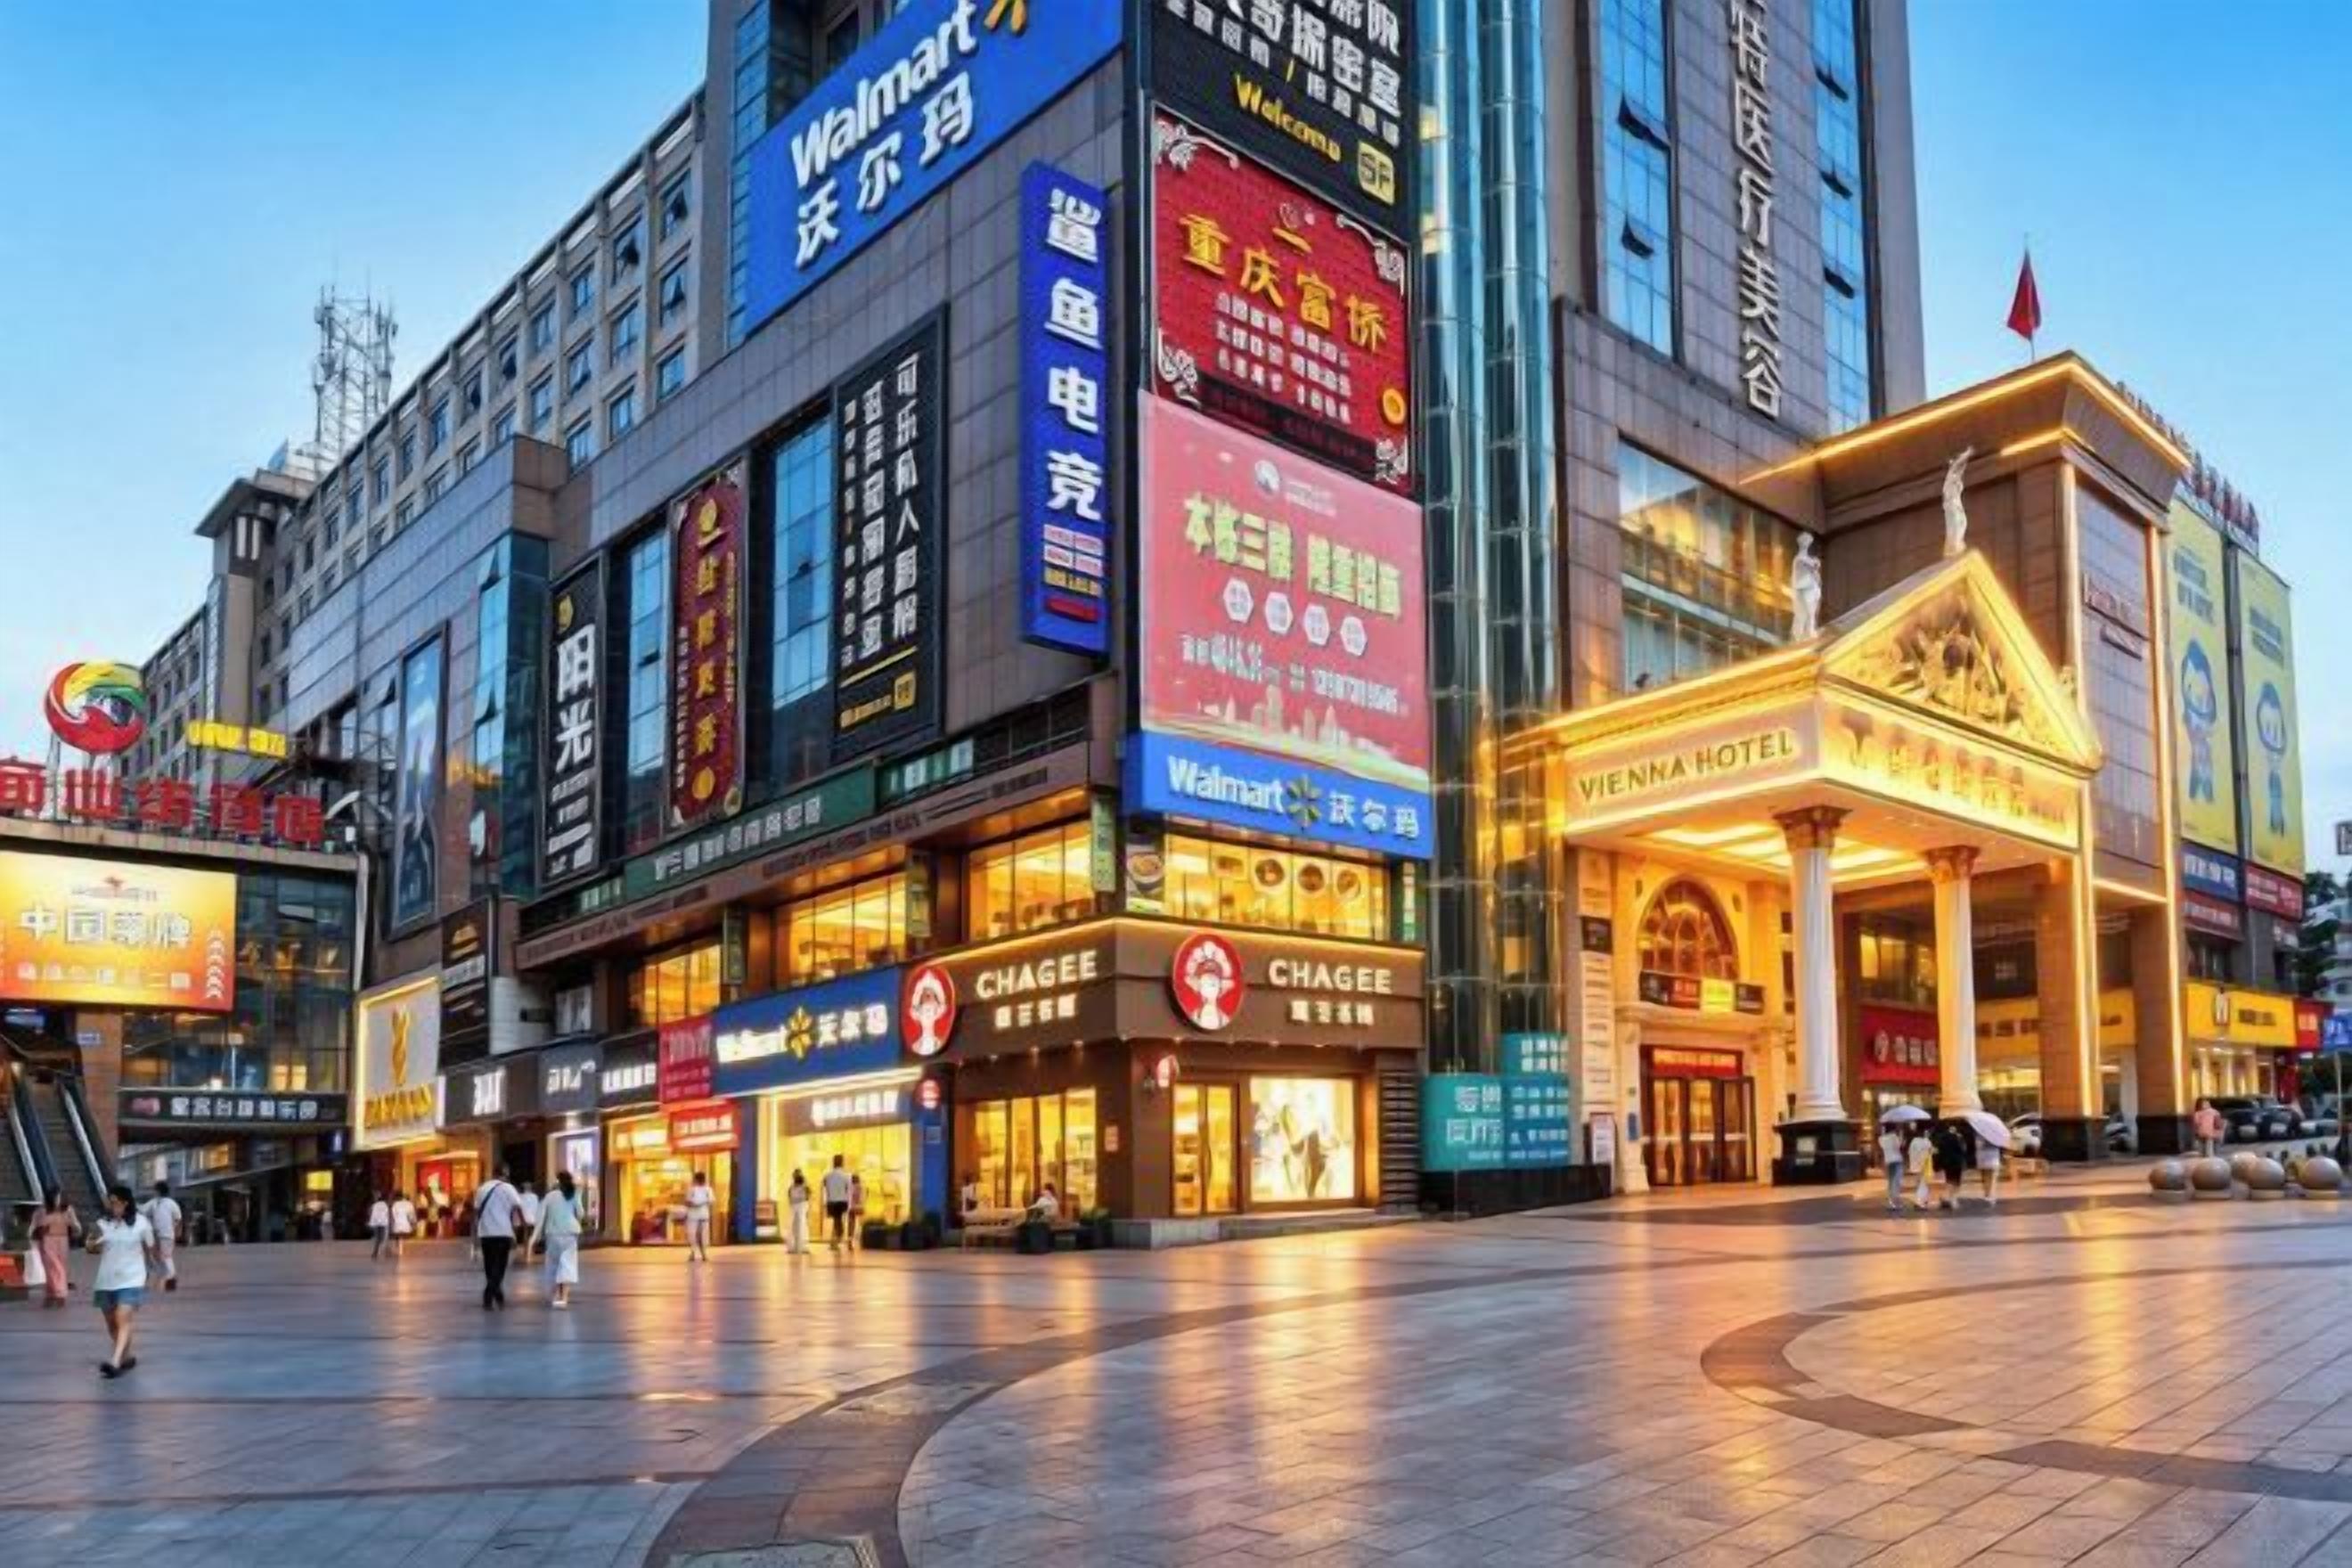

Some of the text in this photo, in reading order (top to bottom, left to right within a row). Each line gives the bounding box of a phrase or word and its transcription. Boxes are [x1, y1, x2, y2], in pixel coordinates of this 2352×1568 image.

[791, 0, 978, 188] Walmart
[795, 70, 975, 267] 沃尔玛
[1167, 754, 1284, 814] Walmart
[1579, 729, 1793, 800] VIENNA HOTEL
[976, 949, 1098, 999] CHAGEE
[1268, 958, 1392, 995] CHAGEE
